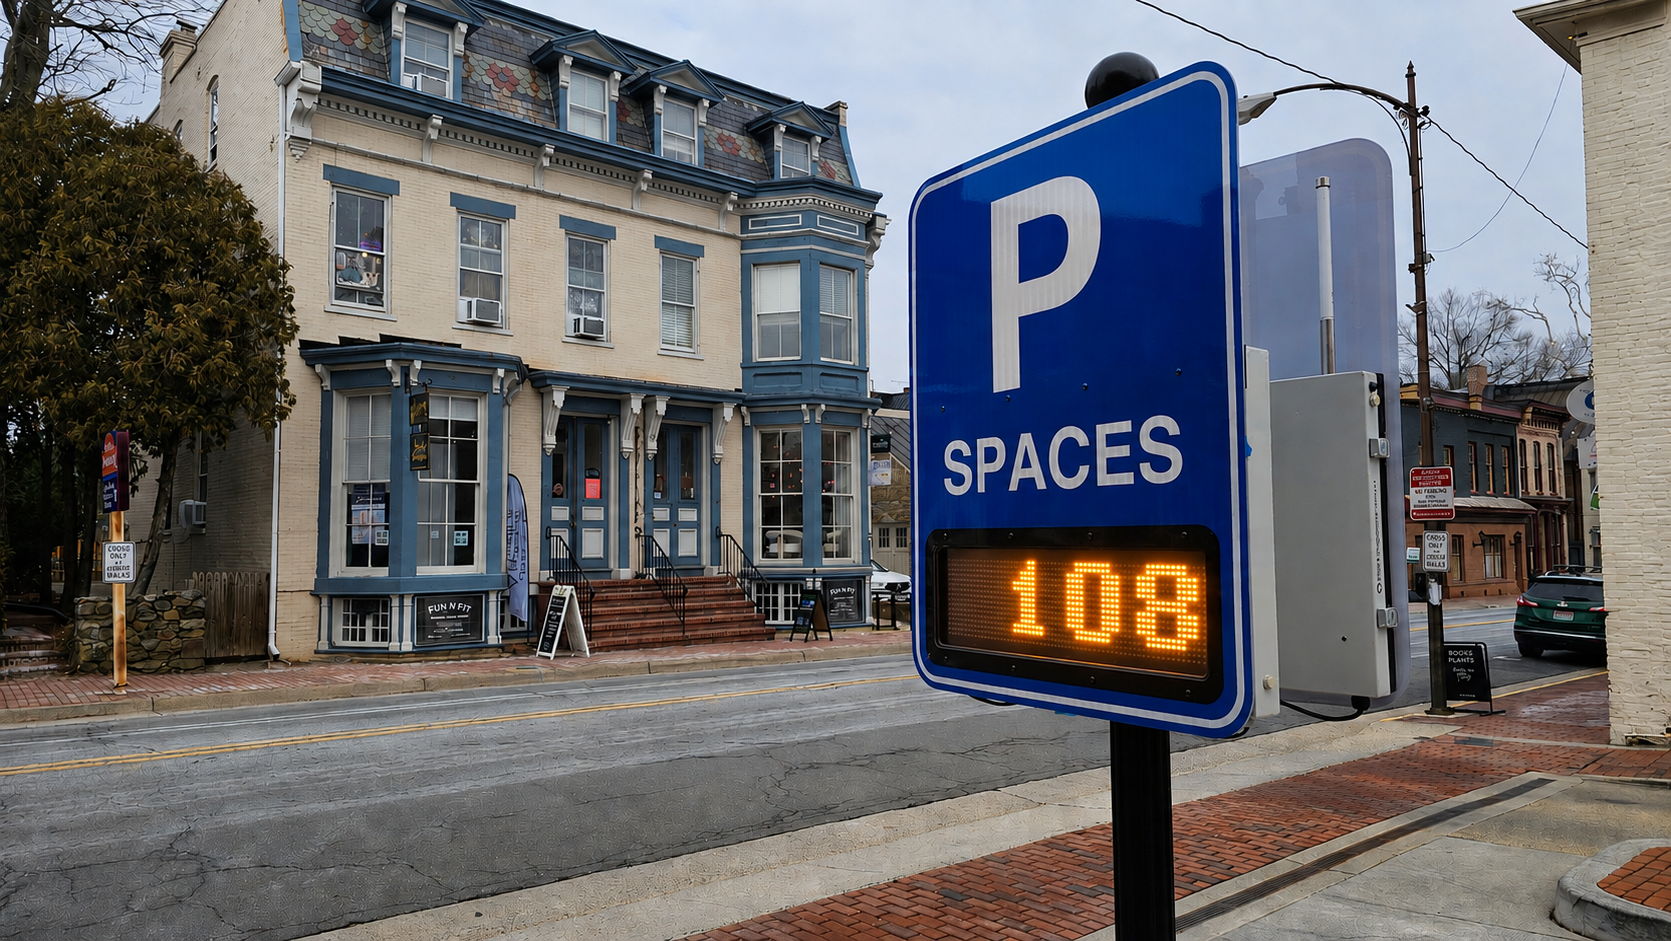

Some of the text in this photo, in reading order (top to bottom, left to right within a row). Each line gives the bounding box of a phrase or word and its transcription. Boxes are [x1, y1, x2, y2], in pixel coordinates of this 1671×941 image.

[990, 175, 1102, 394] P
[943, 414, 1184, 497] SPACES
[428, 602, 472, 614] FUN N FIT
[1012, 559, 1200, 652] 108
